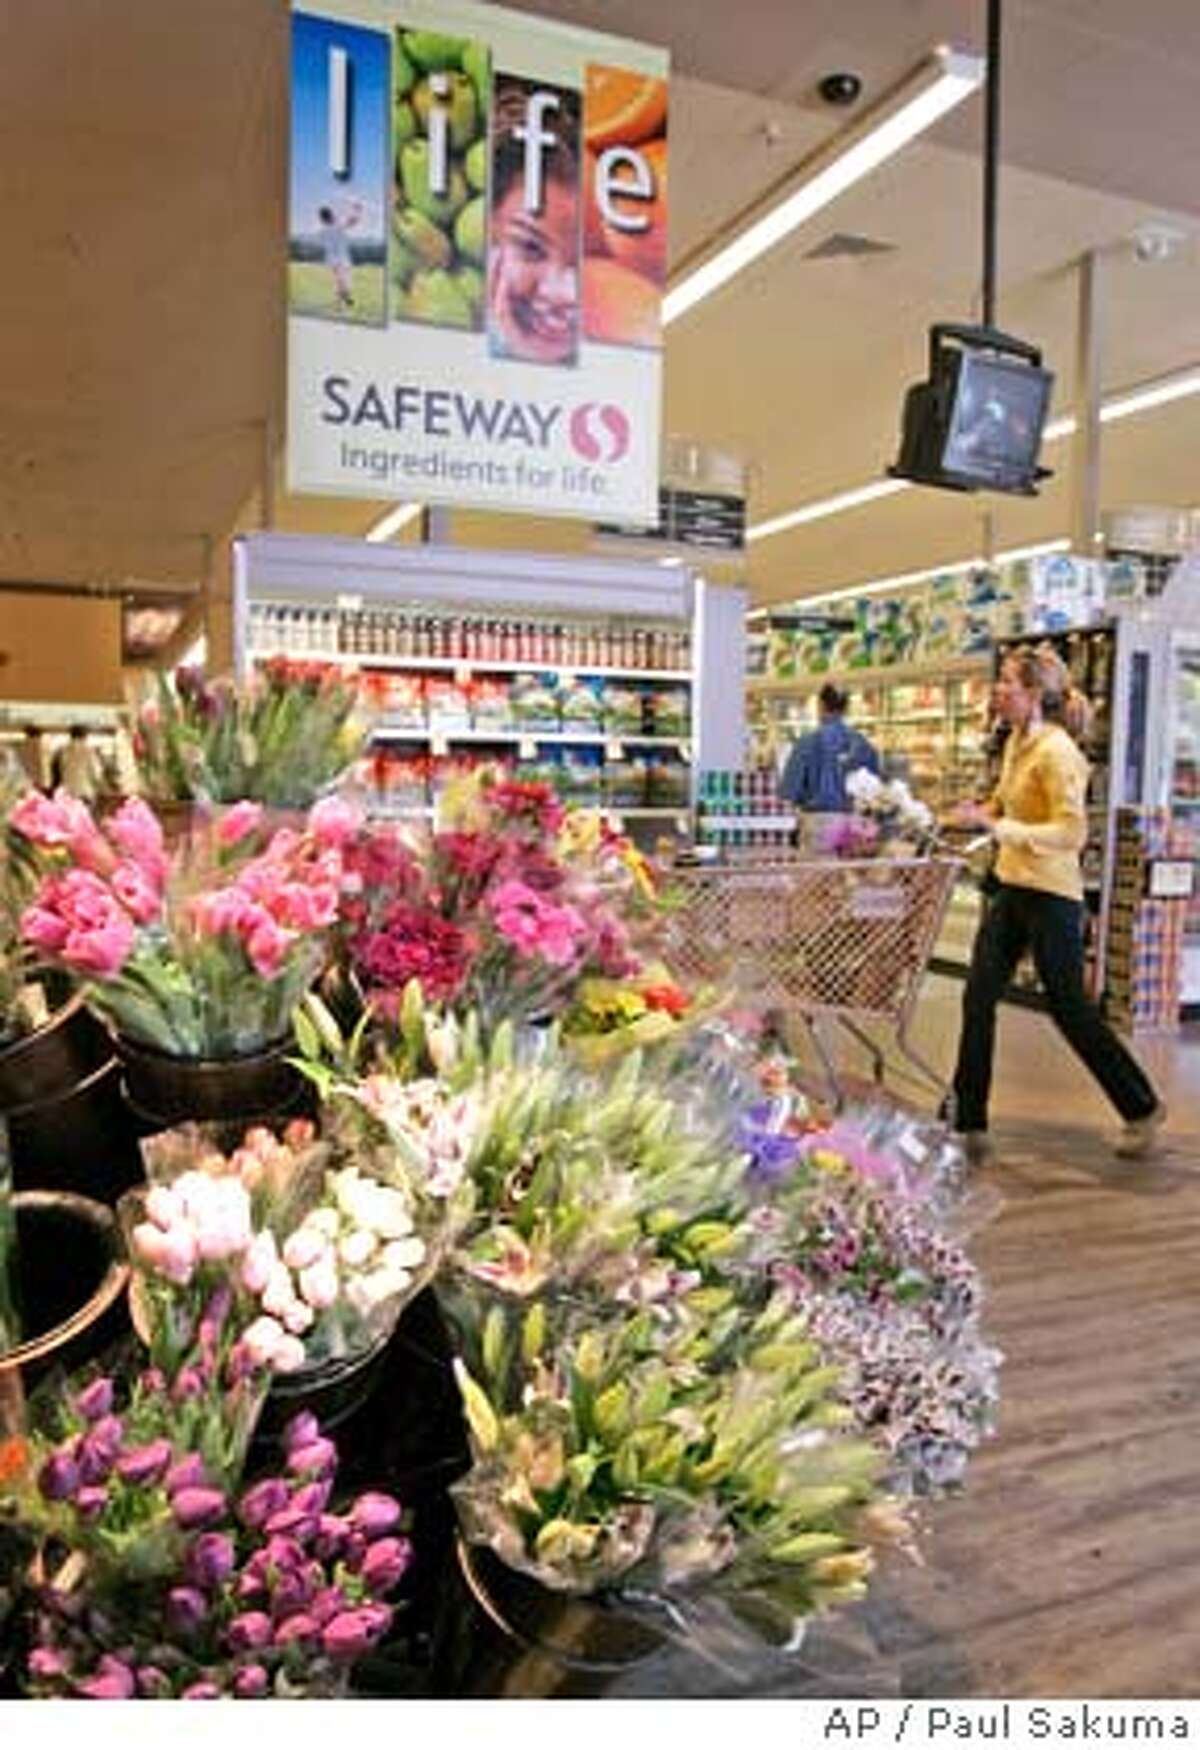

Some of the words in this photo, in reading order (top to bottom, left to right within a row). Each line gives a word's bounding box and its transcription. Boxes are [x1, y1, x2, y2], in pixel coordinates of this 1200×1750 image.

[322, 377, 561, 447] SAFEWAY
[341, 443, 509, 485] Ingredients
[515, 457, 553, 487] for
